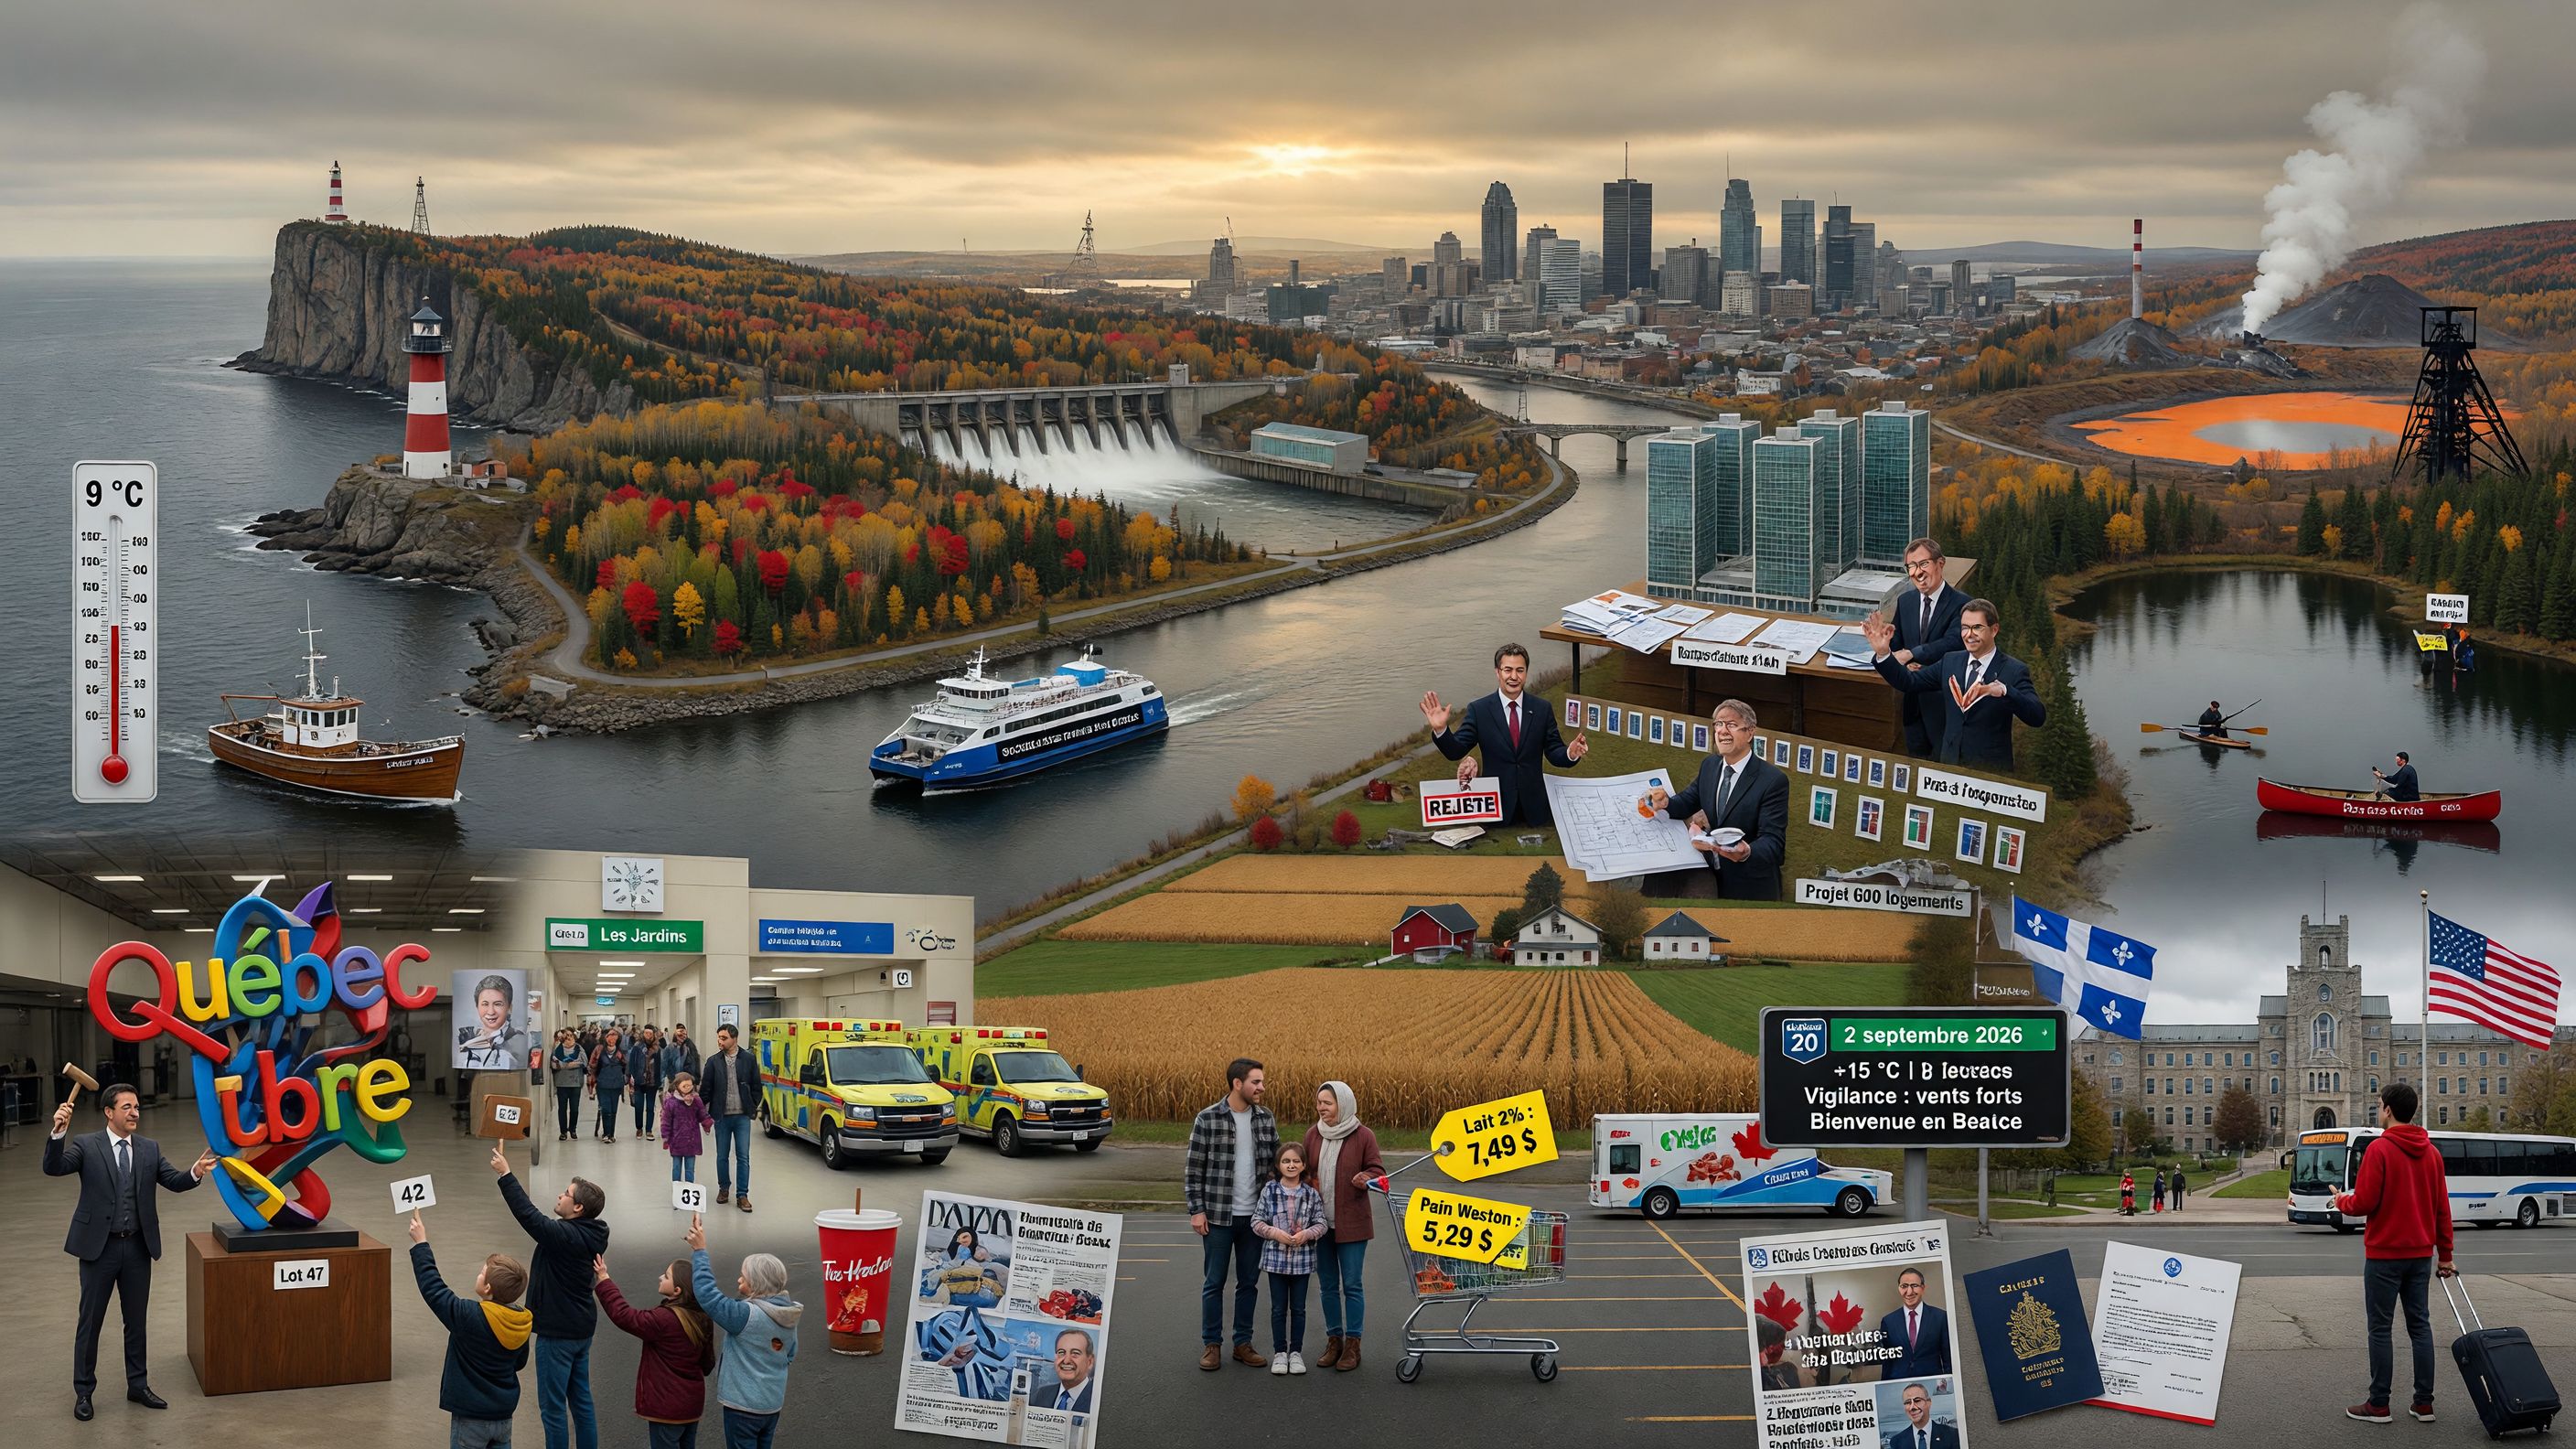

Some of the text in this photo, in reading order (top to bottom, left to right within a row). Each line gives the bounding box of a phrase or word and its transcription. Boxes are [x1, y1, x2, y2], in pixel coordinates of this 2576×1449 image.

[86, 480, 144, 508] 9 °C
[1853, 887, 1882, 905] 600
[601, 927, 627, 942] Les
[631, 928, 687, 944] Jardins
[88, 927, 439, 1065] Québec
[1790, 1033, 1819, 1052] 20
[1844, 1026, 1856, 1044] 2
[1862, 1025, 1970, 1047] septembre
[1975, 1025, 2023, 1045] 2026
[1877, 1061, 1900, 1079] °C
[1804, 1086, 1897, 1109] Vigilance
[1916, 1088, 1970, 1105] vents
[1976, 1086, 2023, 1105] forts
[1463, 1114, 1496, 1134] Lait
[1497, 1106, 1525, 1126] 2%
[1810, 1111, 1916, 1131] Bienvenue
[1922, 1115, 1946, 1131] en
[1466, 1127, 1538, 1167] 7,49 $
[401, 1183, 425, 1204] 42
[1420, 1197, 1453, 1217] Pain
[1457, 1203, 1511, 1227] Weston
[1422, 1219, 1474, 1248] 5,29
[1478, 1228, 1493, 1254] $
[280, 1266, 325, 1283] Lot 47
